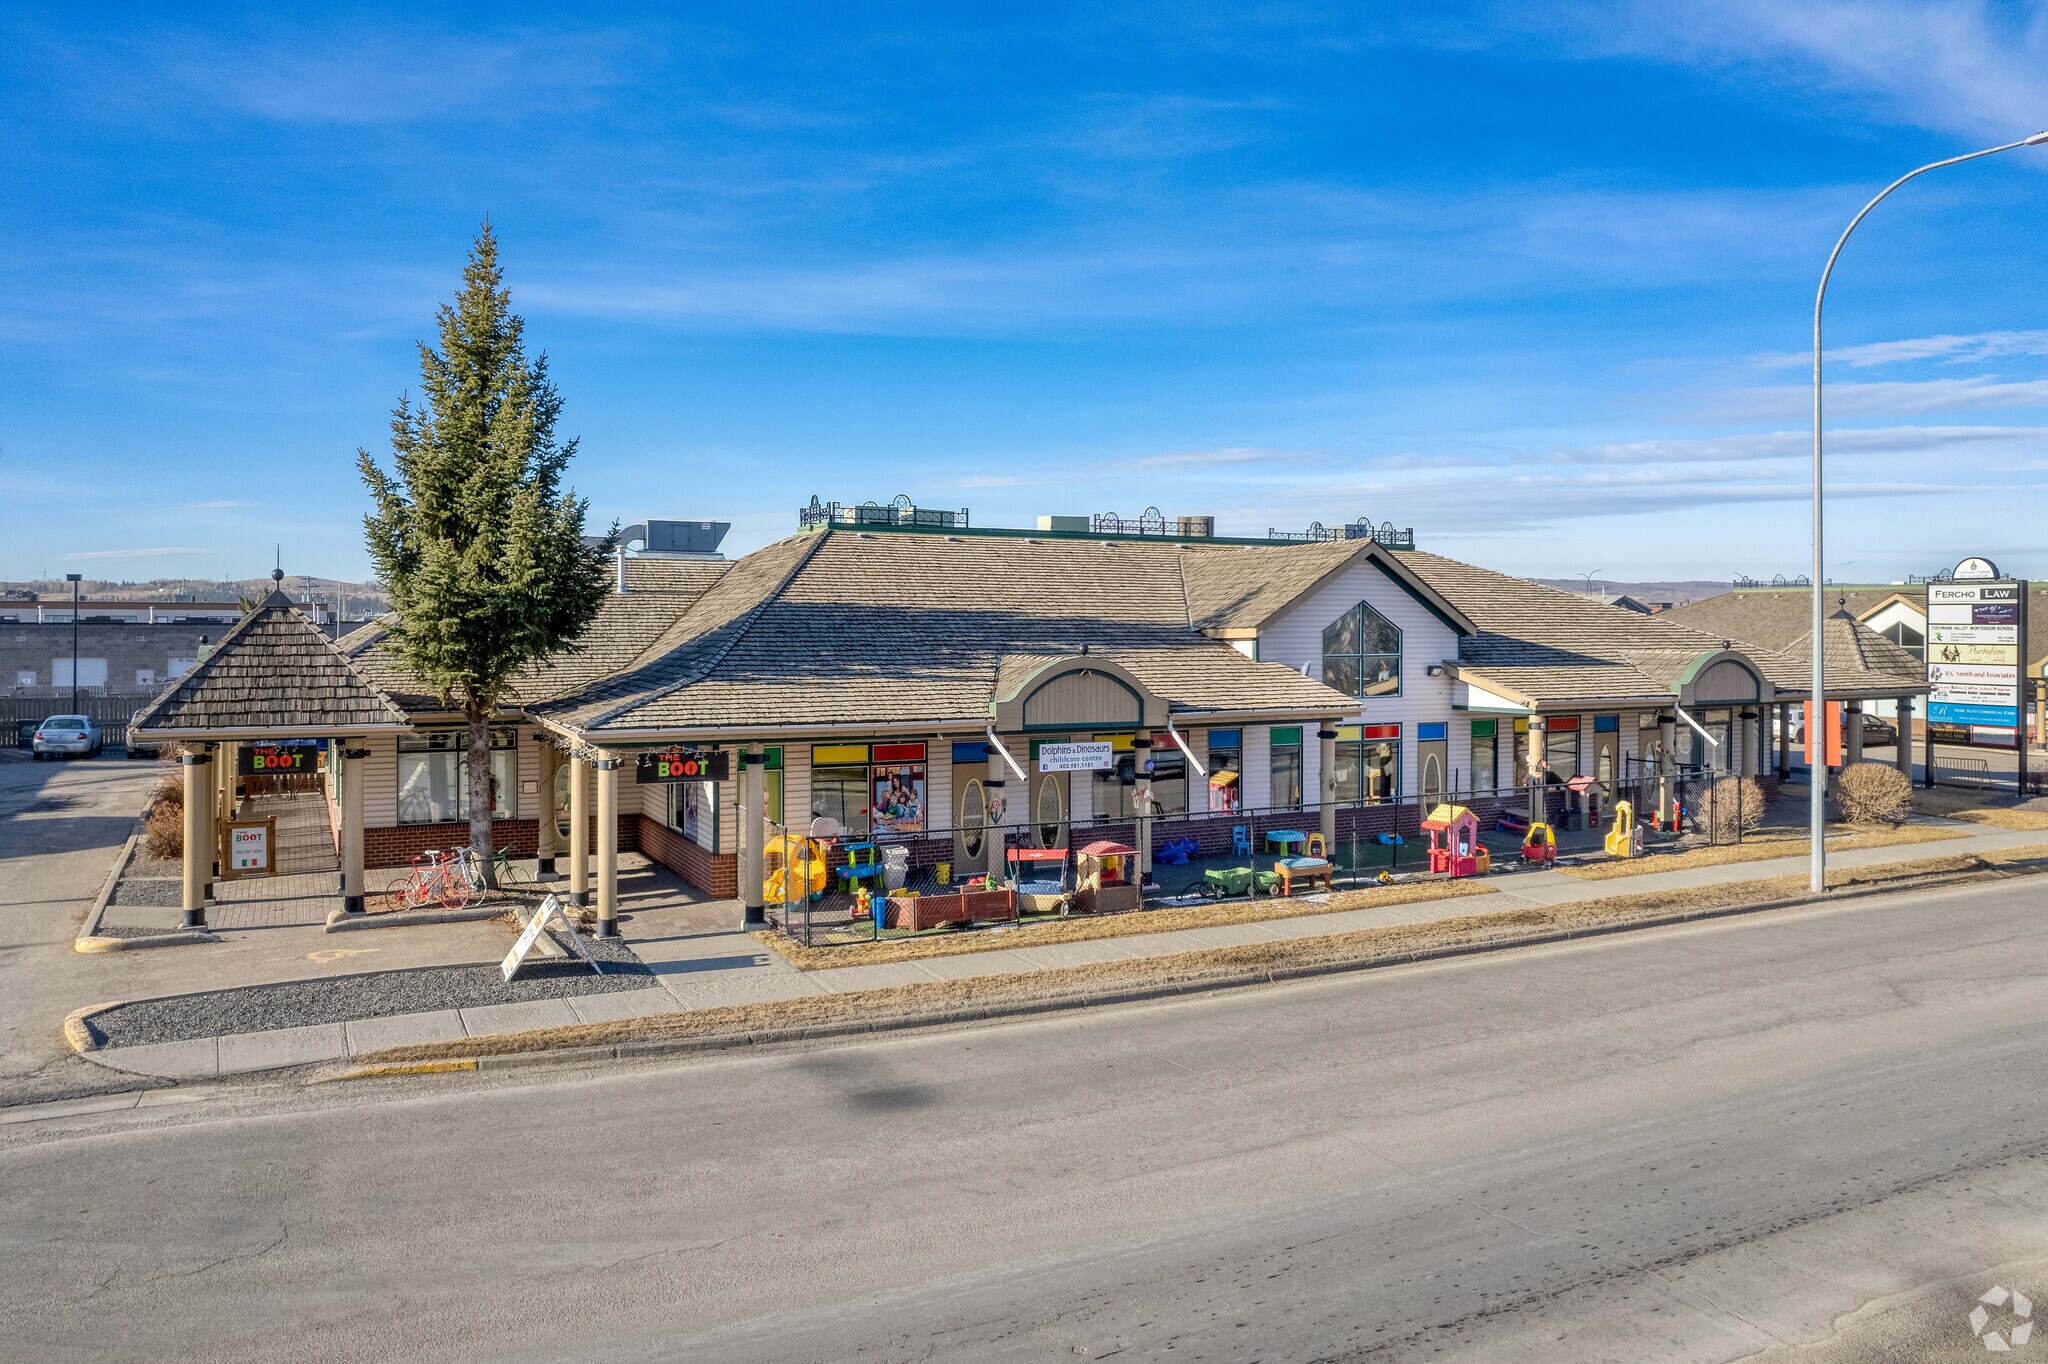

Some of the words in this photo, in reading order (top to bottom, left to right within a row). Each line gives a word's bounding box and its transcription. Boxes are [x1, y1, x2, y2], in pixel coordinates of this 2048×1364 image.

[1935, 590, 1976, 598] FERCHO
[1985, 589, 2010, 598] LAW
[1968, 644, 2006, 657] Portofino
[1042, 746, 1072, 756] Dolphins
[1077, 745, 1110, 754] Dinosaurs
[254, 754, 303, 768] BOOT
[658, 760, 709, 777] BOOT
[236, 834, 262, 842] BOOT
